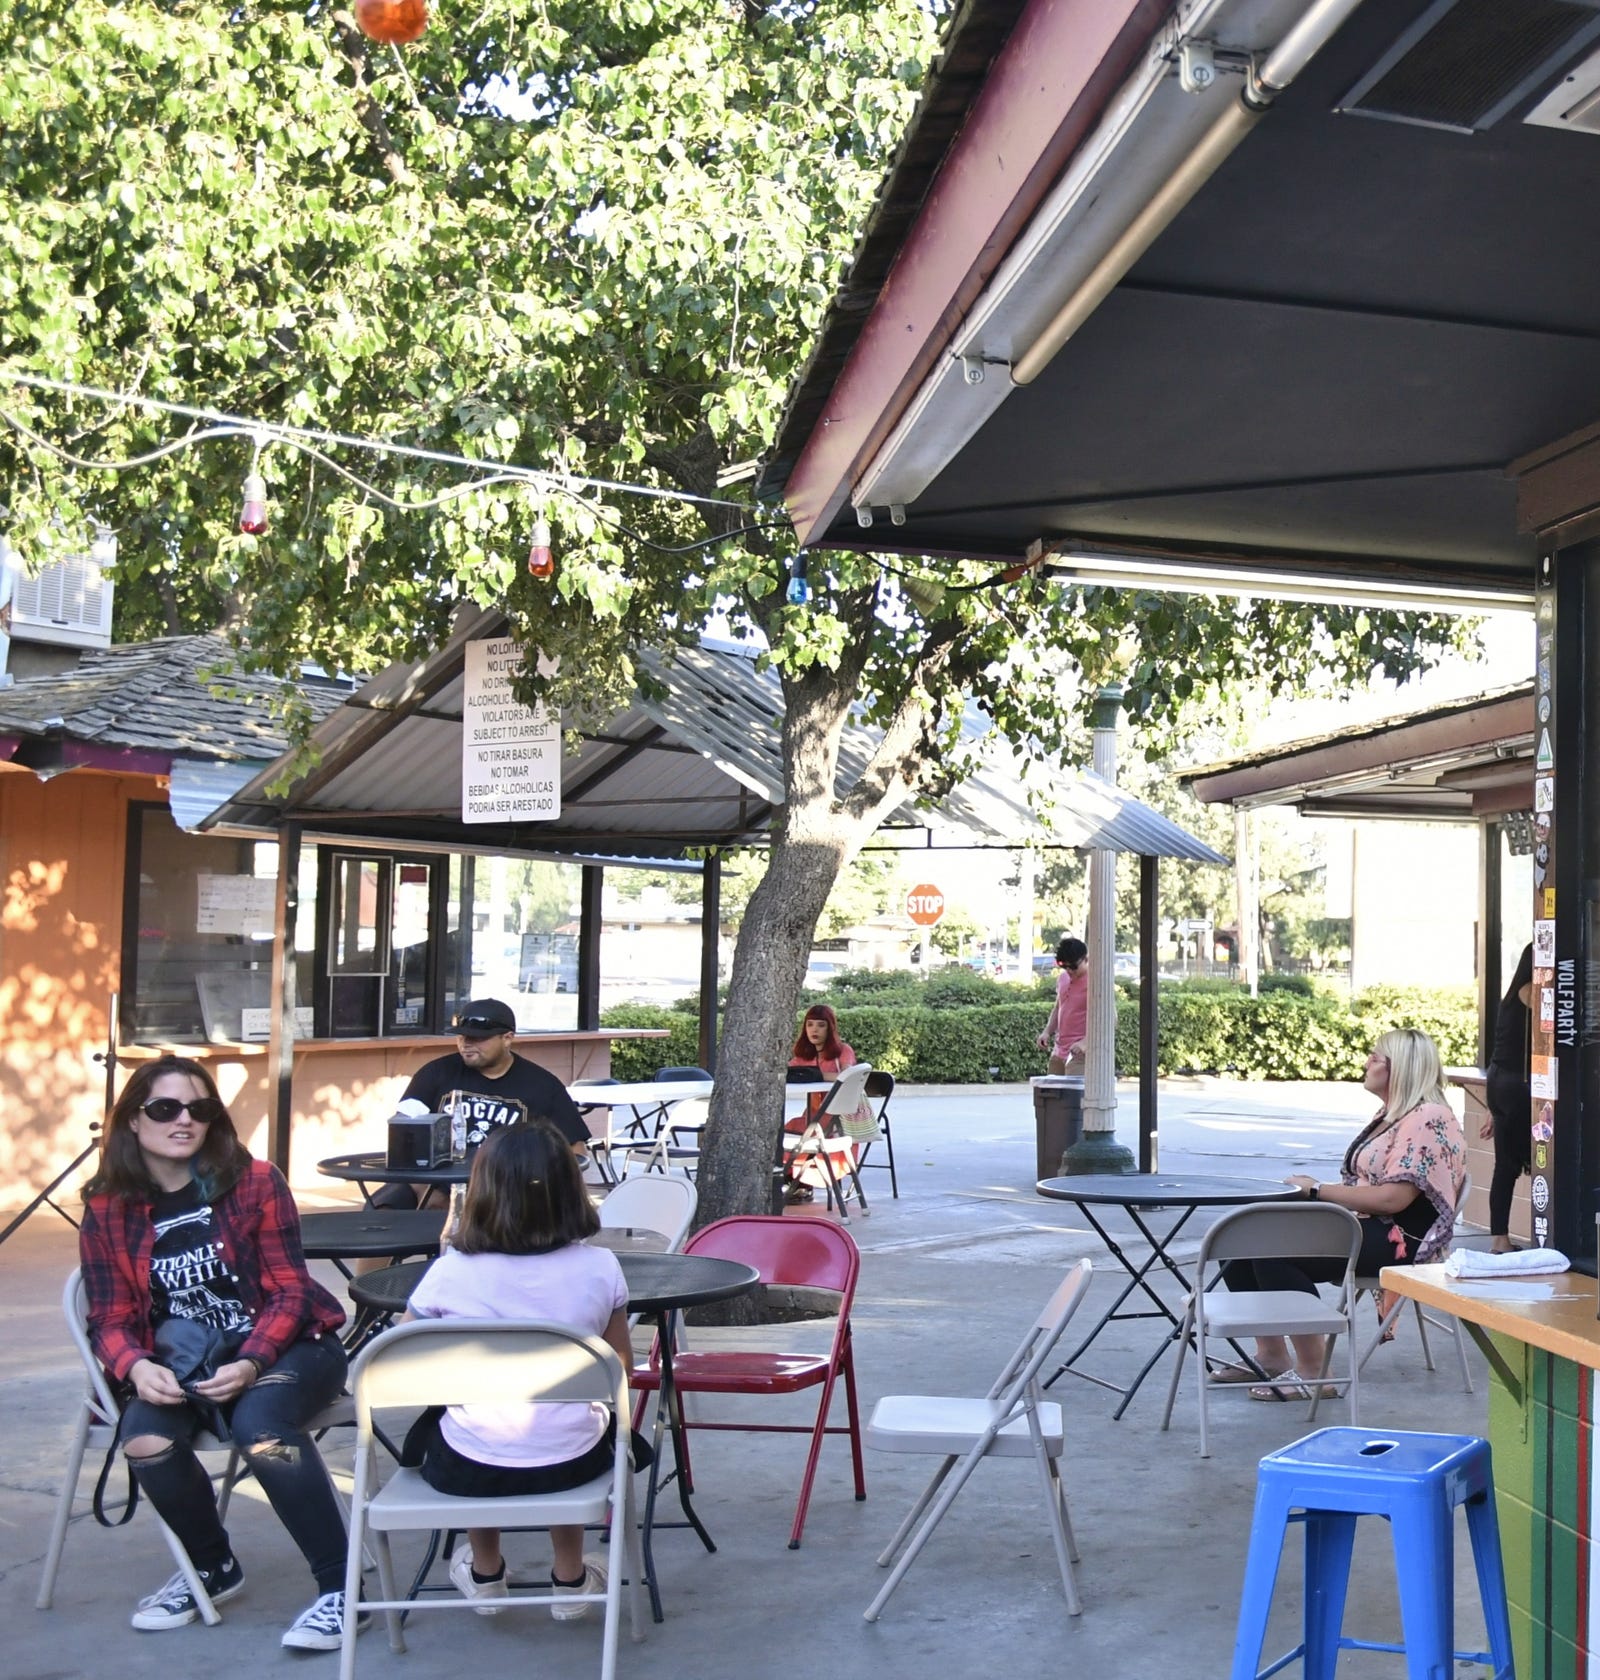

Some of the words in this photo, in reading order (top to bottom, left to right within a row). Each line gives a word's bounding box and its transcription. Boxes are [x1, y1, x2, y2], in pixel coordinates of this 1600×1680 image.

[487, 644, 497, 656] NO
[488, 660, 499, 672] NO
[482, 678, 493, 689] NO
[468, 693, 510, 707] ALCOHOLIC
[482, 710, 524, 723] VIOLATORS
[474, 727, 507, 740] SUBJECT
[508, 726, 518, 738] TO
[519, 724, 549, 737] ARREST
[478, 752, 488, 763] NO
[490, 750, 511, 761] TIRAR
[513, 747, 543, 760] BASURA
[491, 767, 502, 778] NO
[503, 765, 529, 778] TOMAR
[468, 784, 499, 797] BEBIDAS
[501, 781, 554, 795] ALCOHOLICAS
[468, 801, 496, 814] PODRIA
[496, 800, 511, 812] SER
[512, 798, 553, 812] ARESTADO
[908, 895, 943, 914] STOP
[1558, 959, 1575, 998] WOLF
[1557, 1000, 1578, 1047] PARTY
[158, 1259, 229, 1289] WHIT
